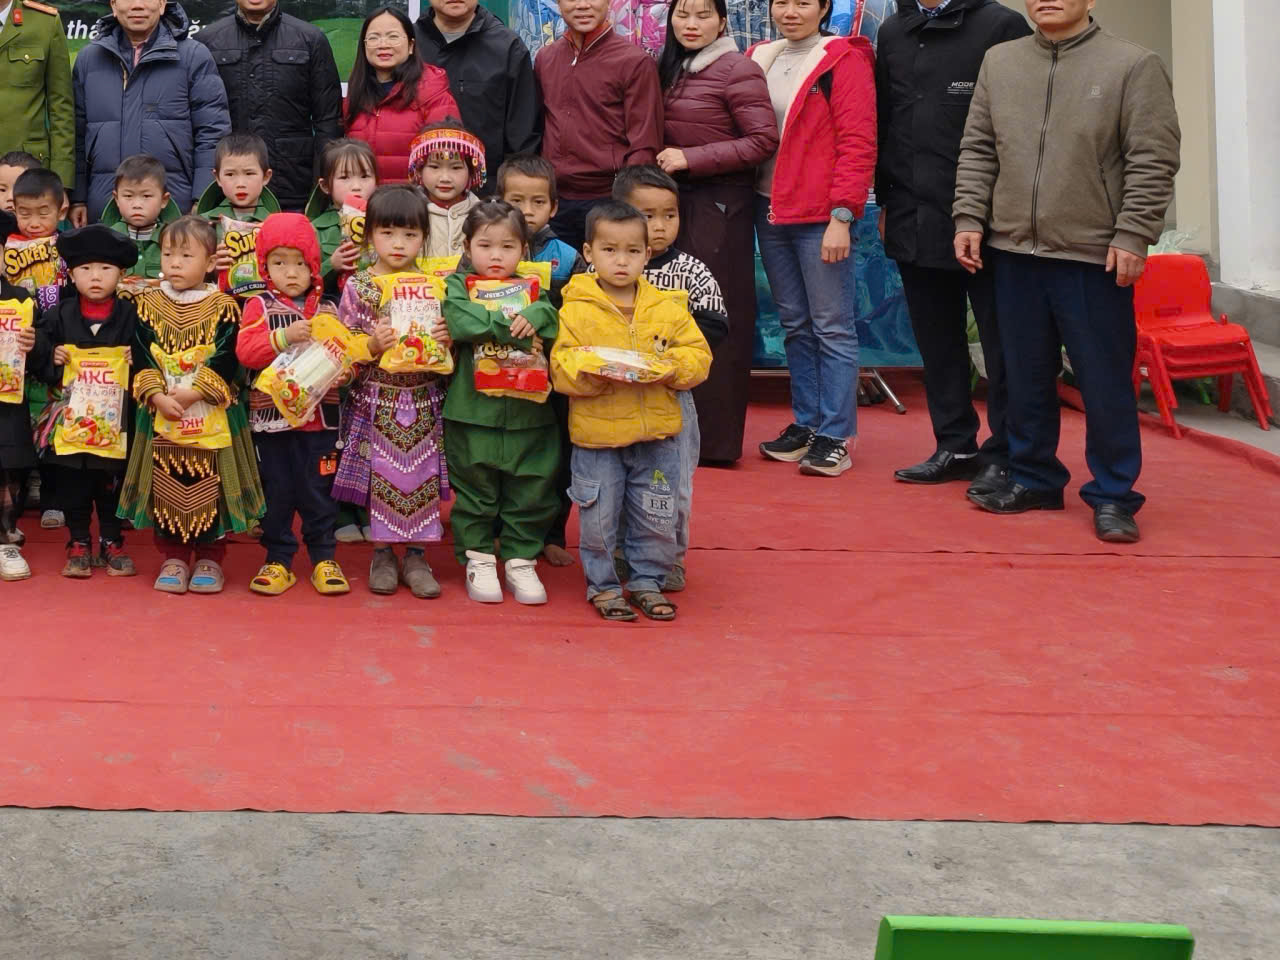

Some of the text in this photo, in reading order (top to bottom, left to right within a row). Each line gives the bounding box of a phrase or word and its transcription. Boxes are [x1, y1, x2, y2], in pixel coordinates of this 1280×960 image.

[4, 242, 51, 275] SUKER
[393, 286, 435, 300] HKC
[77, 370, 115, 385] HKC
[650, 499, 668, 510] ER
